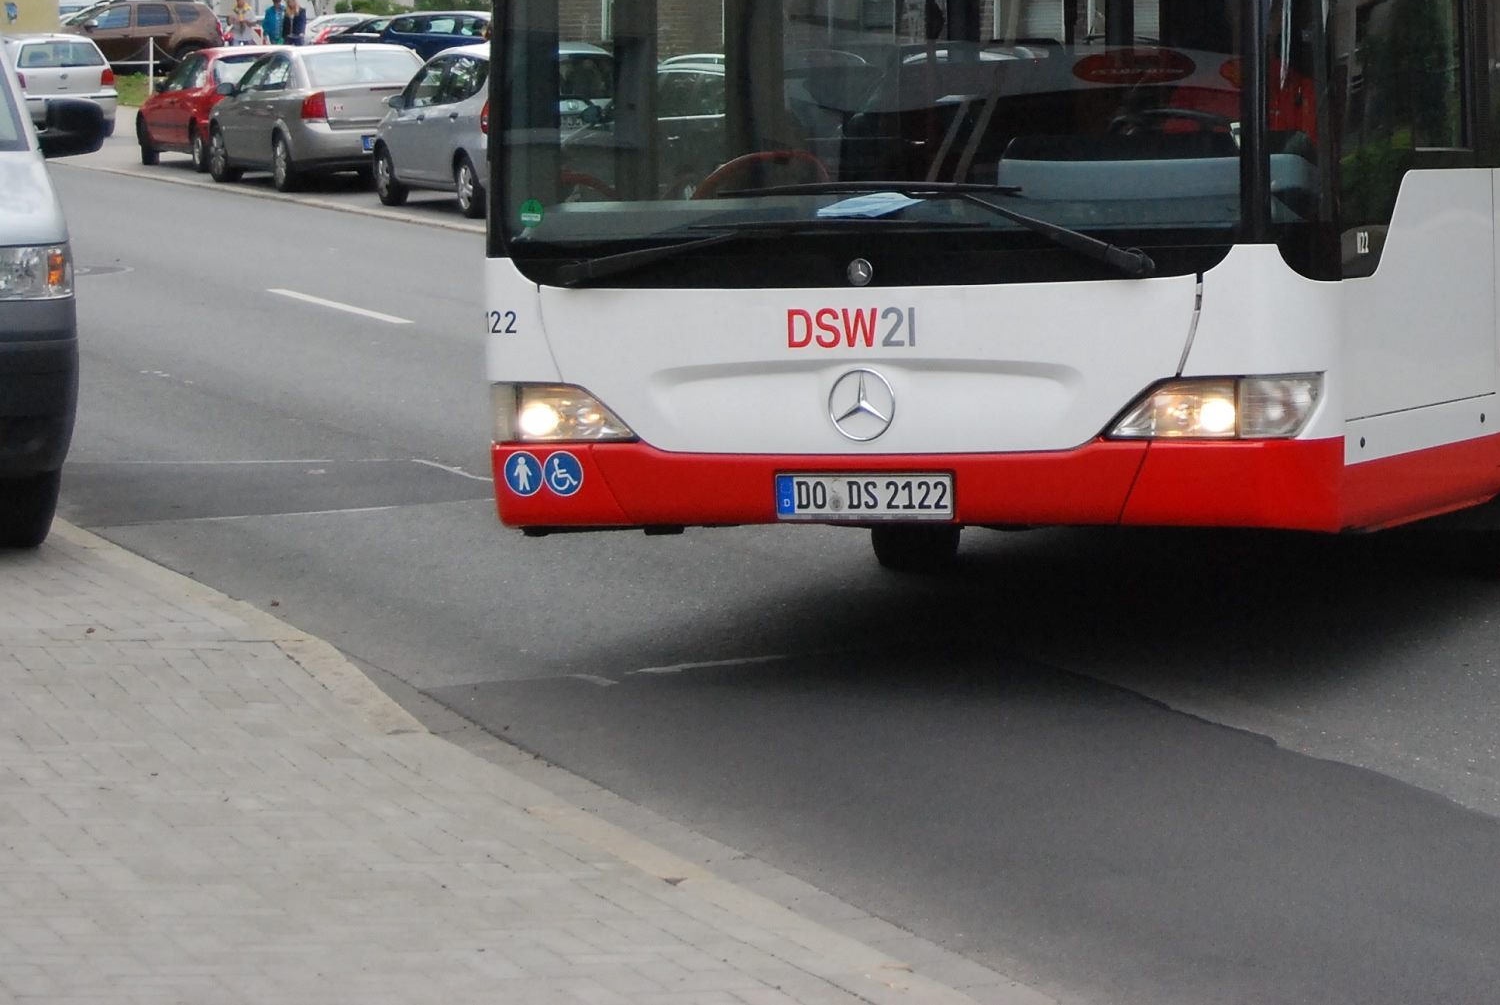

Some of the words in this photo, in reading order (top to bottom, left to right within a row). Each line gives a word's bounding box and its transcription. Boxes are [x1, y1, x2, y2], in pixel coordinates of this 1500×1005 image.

[787, 306, 916, 348] DSW21
[796, 480, 827, 510] DO
[847, 480, 879, 510] DS
[885, 480, 949, 510] 2122
